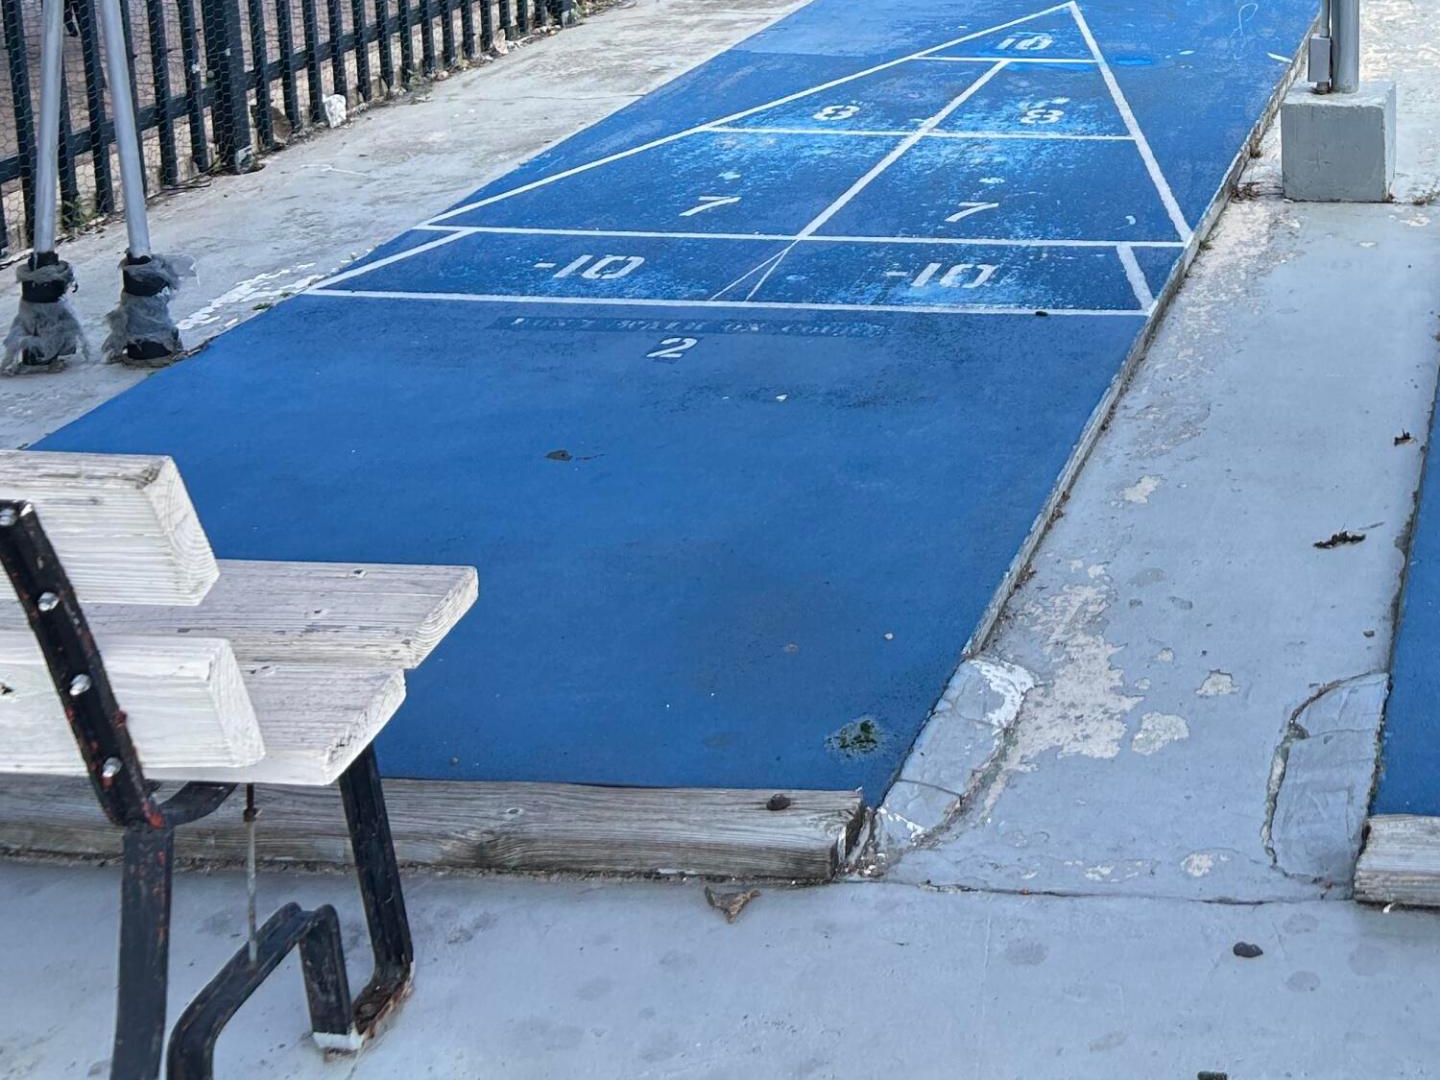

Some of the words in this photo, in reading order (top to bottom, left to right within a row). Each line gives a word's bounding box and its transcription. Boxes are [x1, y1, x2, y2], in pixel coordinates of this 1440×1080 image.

[999, 36, 1052, 49] 10
[813, 106, 859, 120] 8
[1021, 110, 1063, 123] 8
[680, 197, 740, 216] 7
[945, 202, 998, 222] 7
[535, 255, 644, 279] -10
[887, 263, 998, 288] -10
[648, 338, 697, 357] 2
